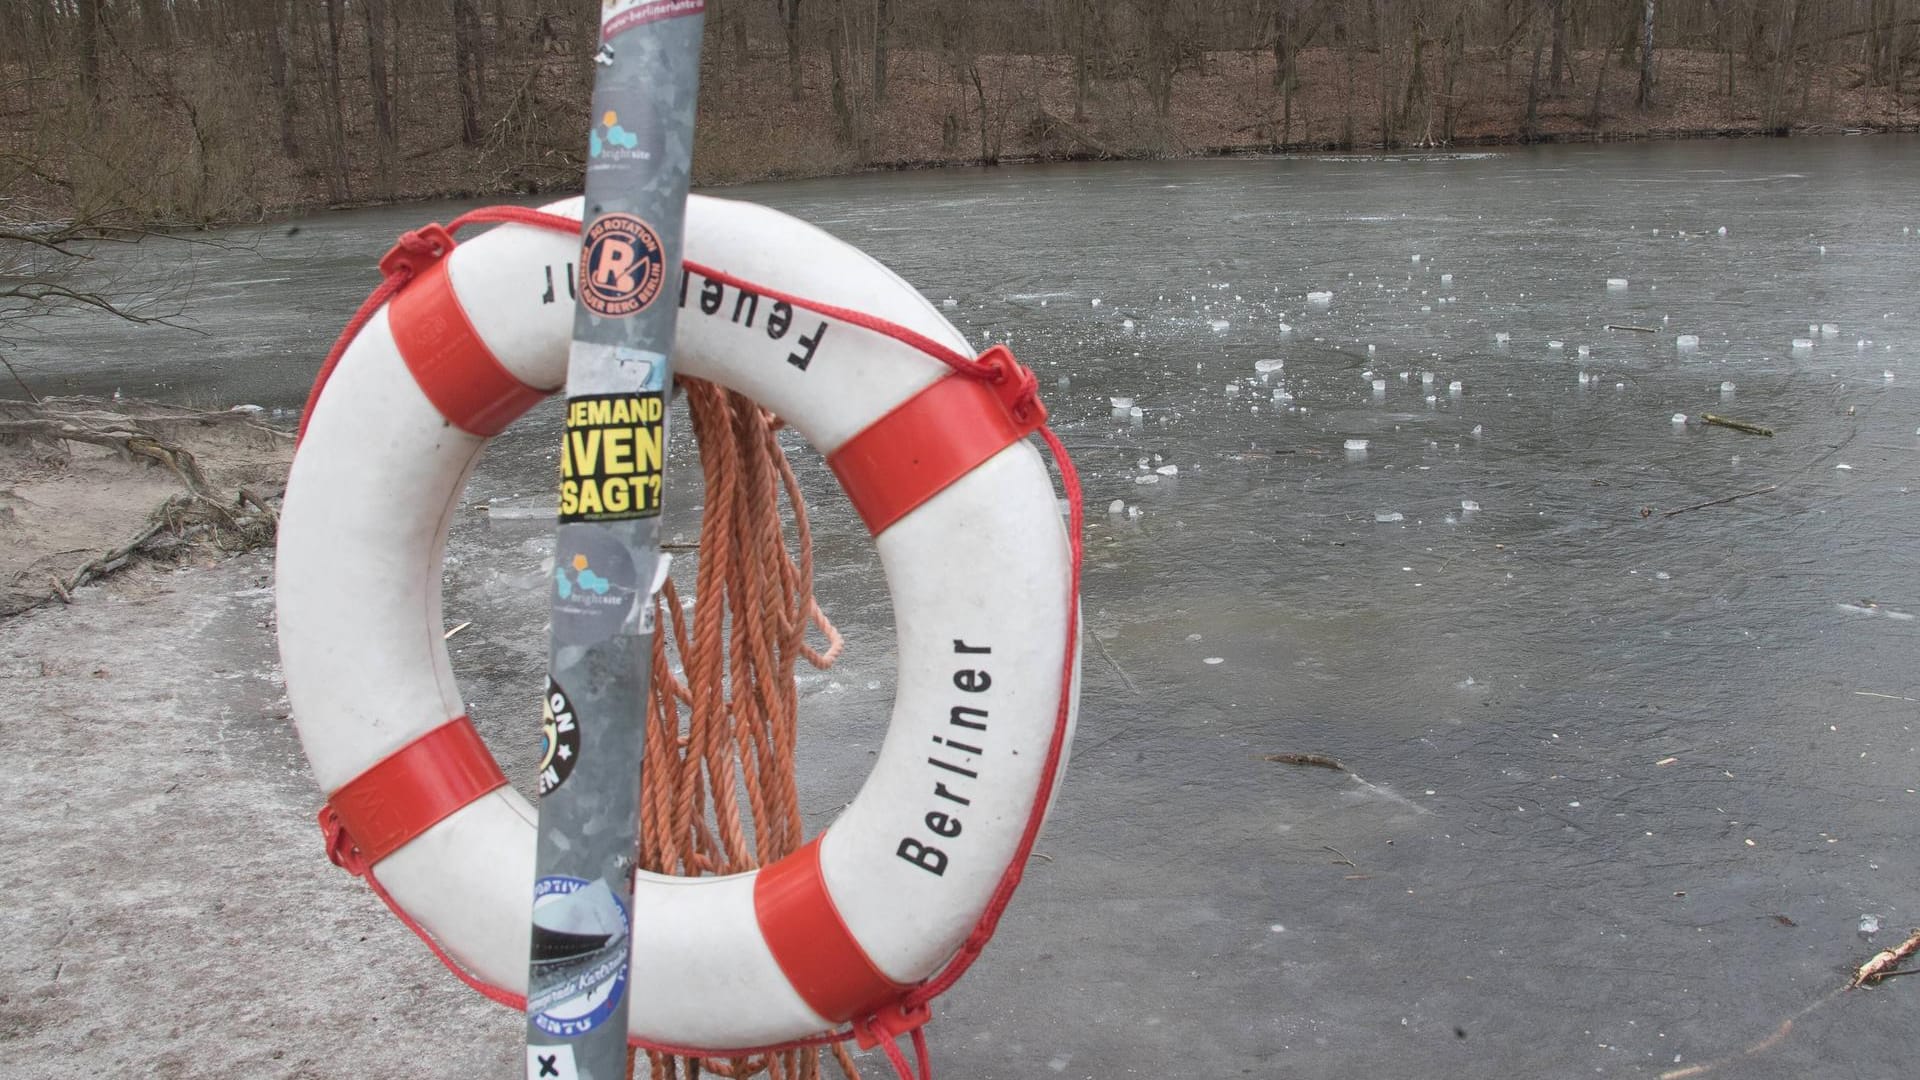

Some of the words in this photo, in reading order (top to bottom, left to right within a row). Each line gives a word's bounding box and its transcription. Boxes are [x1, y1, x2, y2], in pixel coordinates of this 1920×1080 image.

[603, 219, 657, 253] ROTATION
[606, 298, 639, 313] BERG
[638, 262, 661, 302] BERLIN
[567, 397, 662, 428] JEMAND
[559, 474, 662, 516] SAGT?
[896, 639, 992, 877] Berliner
